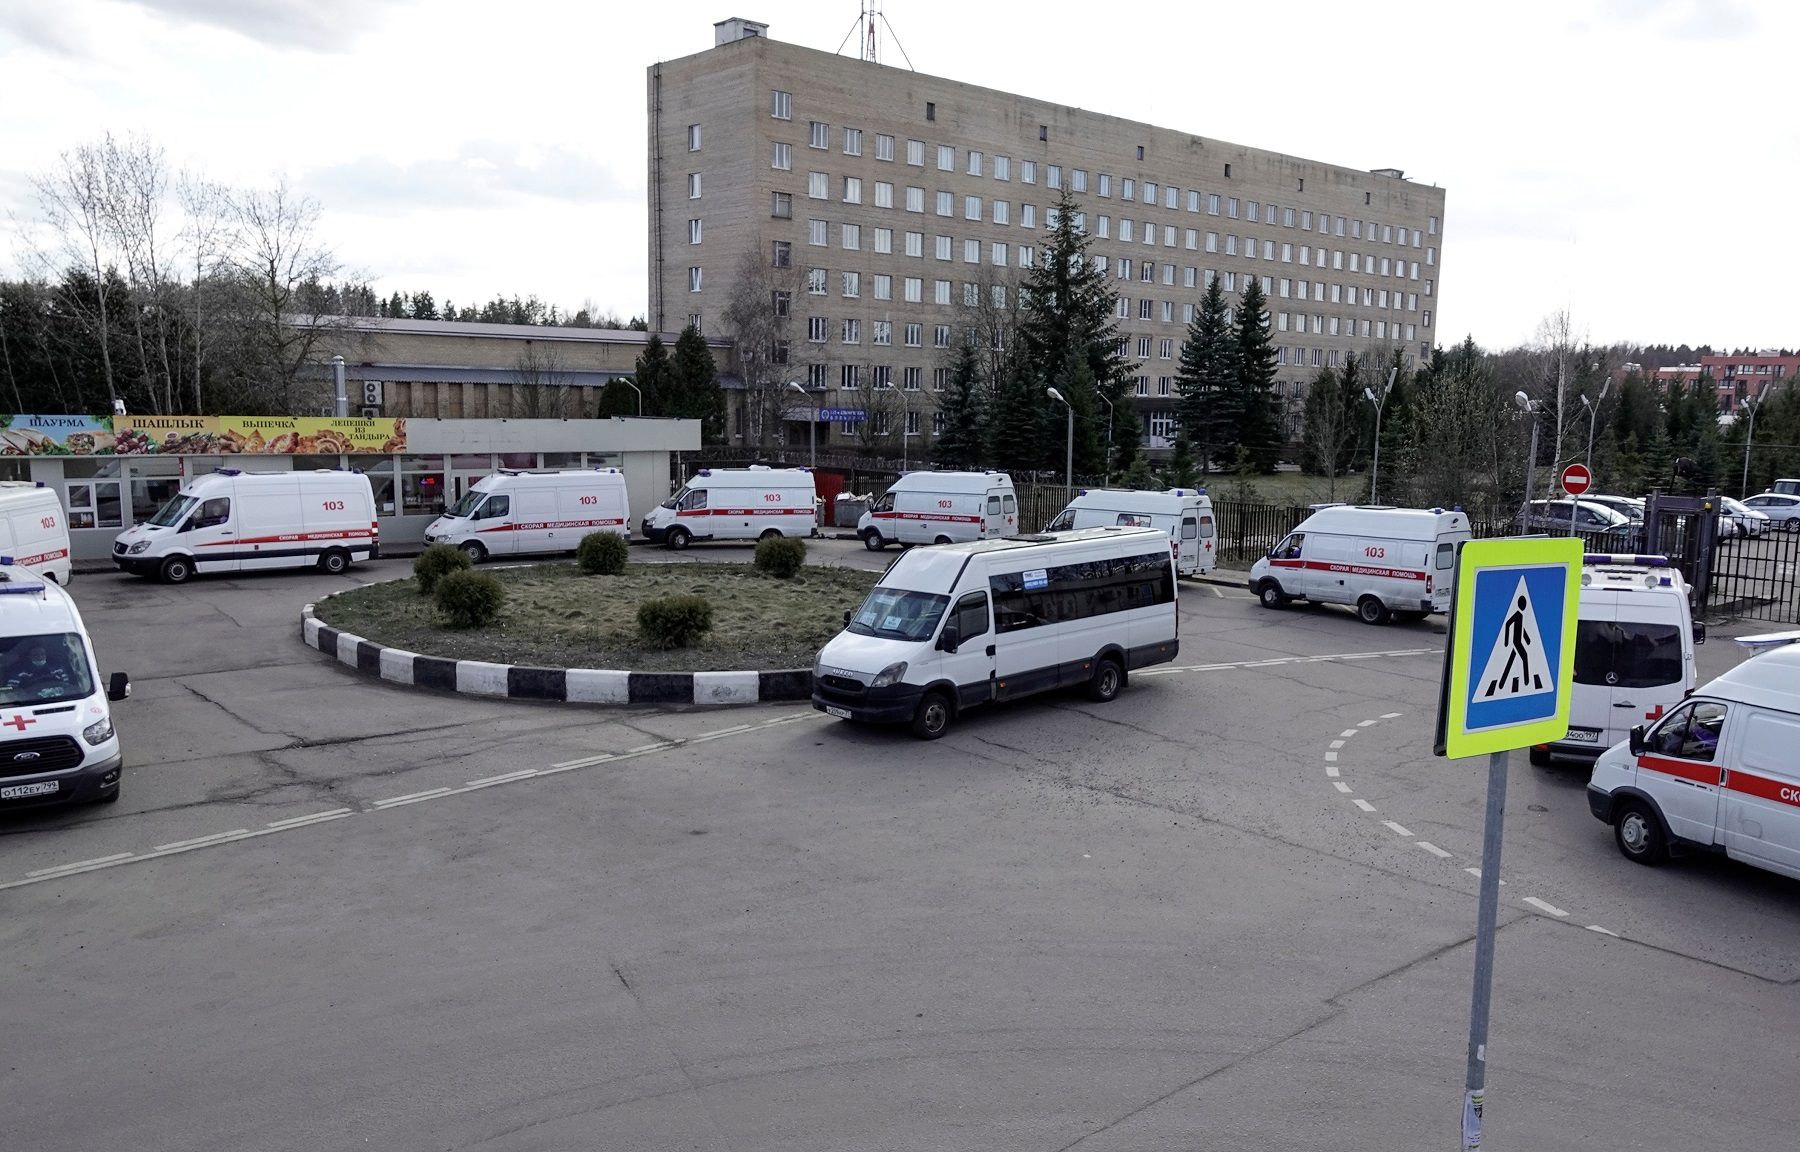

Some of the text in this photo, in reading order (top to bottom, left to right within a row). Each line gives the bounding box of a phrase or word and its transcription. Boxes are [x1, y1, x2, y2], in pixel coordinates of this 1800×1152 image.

[30, 418, 85, 428] ШАУРМА
[133, 418, 204, 429] ШАШЛЫК
[242, 420, 296, 429] ВЫПЕЧКА
[331, 419, 376, 427] ЛЕПЕШКИ
[349, 433, 391, 441] ТАНДЫРА
[579, 496, 598, 505] 103
[763, 493, 781, 502] 103
[322, 500, 345, 511] 103
[937, 500, 953, 509] 103
[40, 516, 56, 529] 103
[546, 520, 590, 529] МЕДИЦИНСКАЯ
[591, 519, 618, 527] ПОМОЩЬ
[1364, 546, 1385, 559] 103
[1329, 564, 1417, 579] СКОРАЯ МЕДИЦИНСКАЯ ПОМОЩЬ
[832, 668, 854, 678] IVECO
[1780, 787, 1800, 803] СК
